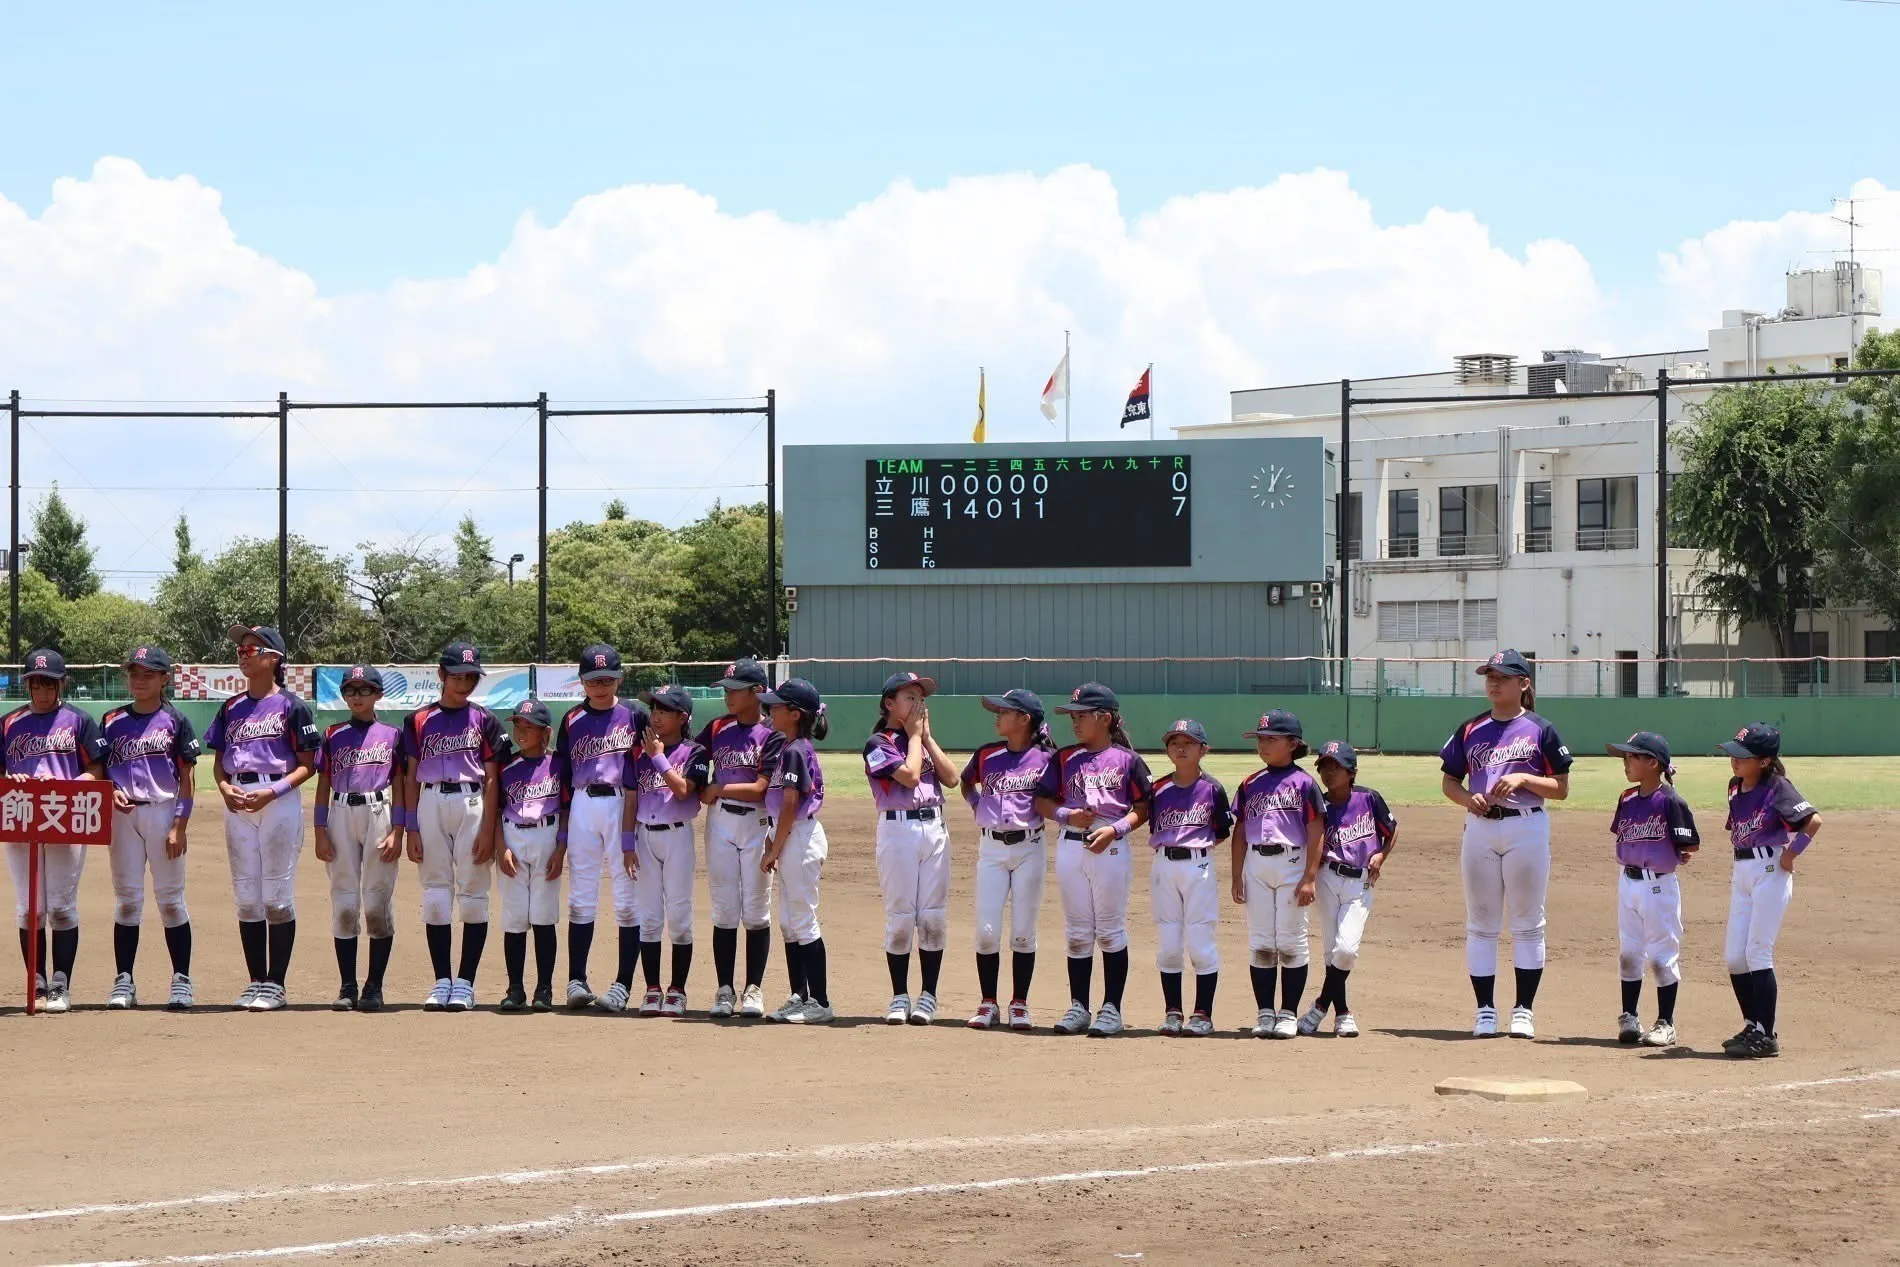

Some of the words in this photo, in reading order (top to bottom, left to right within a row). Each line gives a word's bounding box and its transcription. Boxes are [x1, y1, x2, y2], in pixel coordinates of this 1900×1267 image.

[877, 459, 923, 474] TEAM
[964, 460, 977, 471] 二
[987, 460, 1000, 471] 三
[1010, 459, 1023, 472] 四
[1033, 459, 1046, 471] 五
[1056, 458, 1069, 471] 六
[1080, 457, 1092, 471] 七
[1102, 459, 1115, 470] 八
[1125, 457, 1138, 470] 九
[1148, 456, 1160, 470] 十
[1174, 456, 1184, 469] R
[941, 475, 955, 495] 0
[964, 474, 979, 494] 0
[987, 474, 1002, 494] 0
[1010, 474, 1025, 494] 0
[1033, 473, 1048, 494] 0
[1172, 471, 1187, 492] 0
[942, 498, 951, 519] 1
[964, 498, 979, 519] 4
[987, 498, 1002, 518] 0
[1011, 498, 1020, 519] 1
[1034, 497, 1044, 519] 1
[1172, 496, 1186, 517] 7
[869, 527, 878, 539] B
[923, 527, 934, 538] H
[869, 542, 878, 554] S
[923, 541, 933, 553] E
[214, 675, 250, 693] nip
[0, 788, 102, 835] 飾支部
